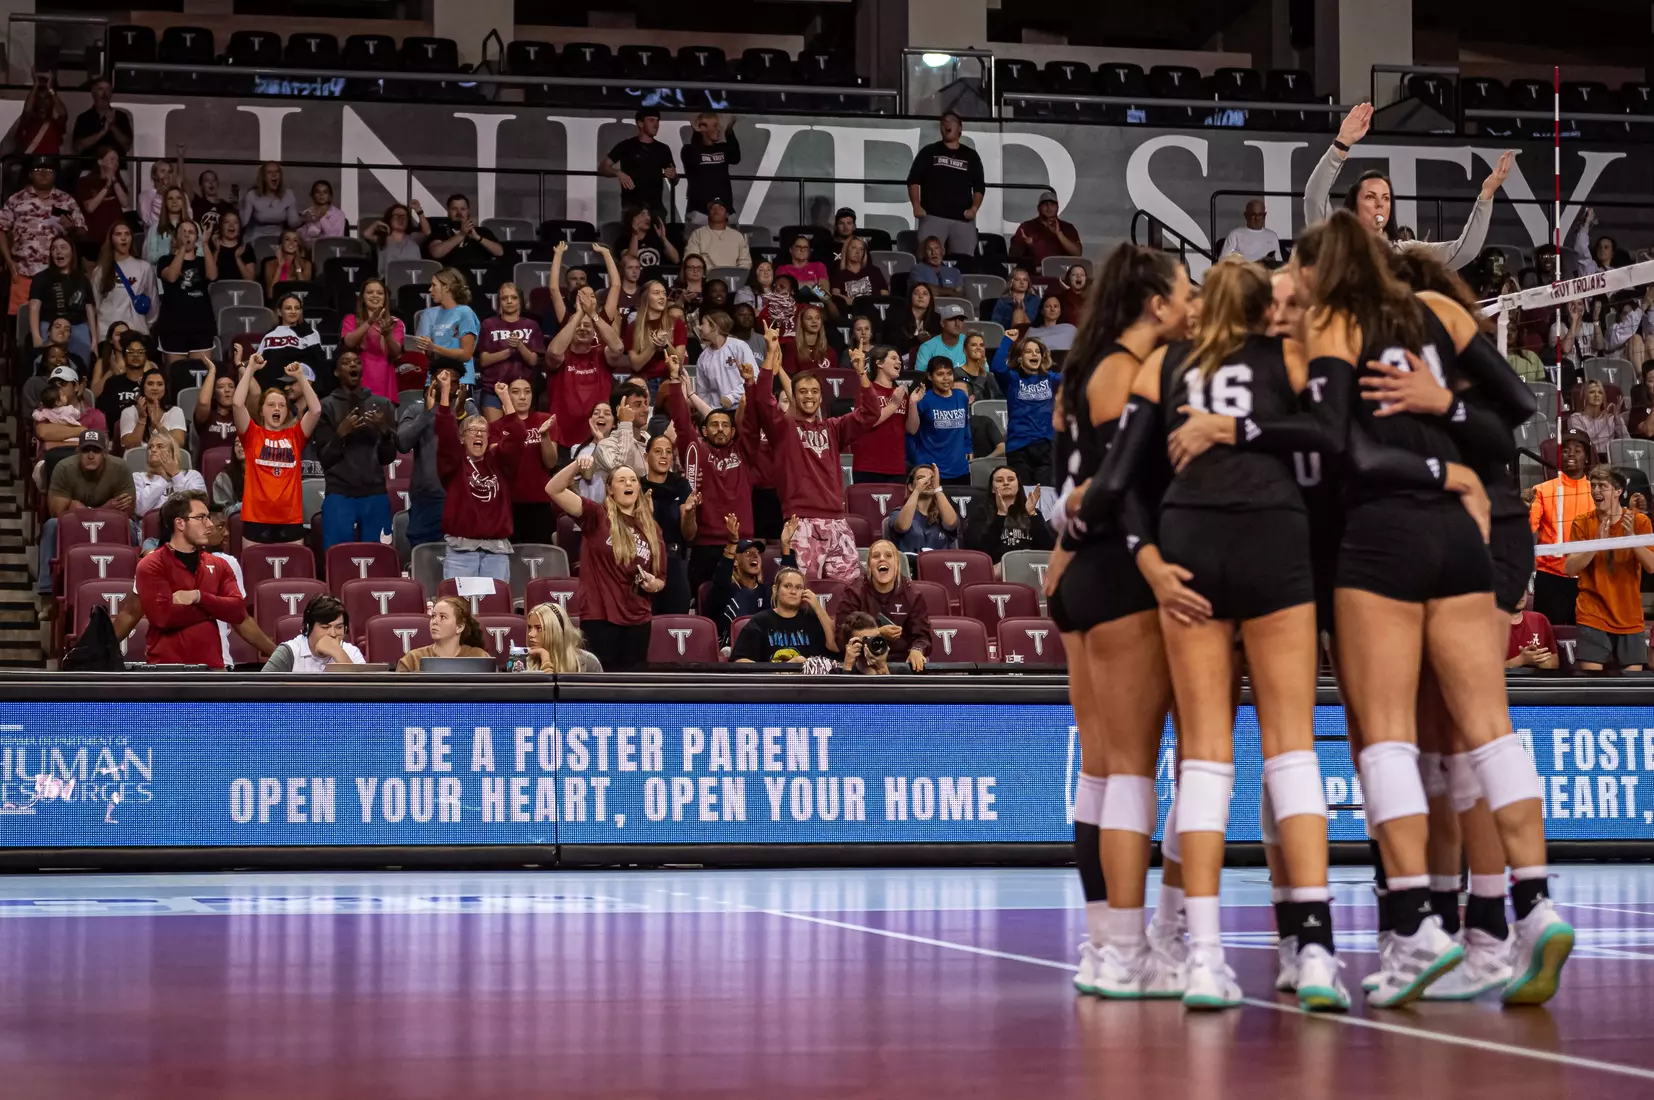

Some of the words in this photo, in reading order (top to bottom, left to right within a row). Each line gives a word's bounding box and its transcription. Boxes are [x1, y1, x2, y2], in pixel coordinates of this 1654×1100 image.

[1572, 273, 1607, 295] TROJANS
[263, 336, 300, 349] TIGERS
[1184, 362, 1254, 417] 16
[933, 408, 966, 420] HARVEST
[688, 464, 696, 492] TROJAN
[404, 727, 452, 772] BE
[471, 727, 495, 772] A
[514, 727, 663, 772] FOSTER
[682, 727, 833, 772] PARENT
[1552, 728, 1654, 772] FOSTE
[0, 781, 153, 804] ESOURCES
[229, 777, 336, 823] OPEN
[355, 777, 462, 823] YOUR
[482, 777, 626, 828] HEART,
[644, 777, 747, 822] OPEN
[764, 777, 866, 822] YOUR
[884, 777, 999, 822] HOME
